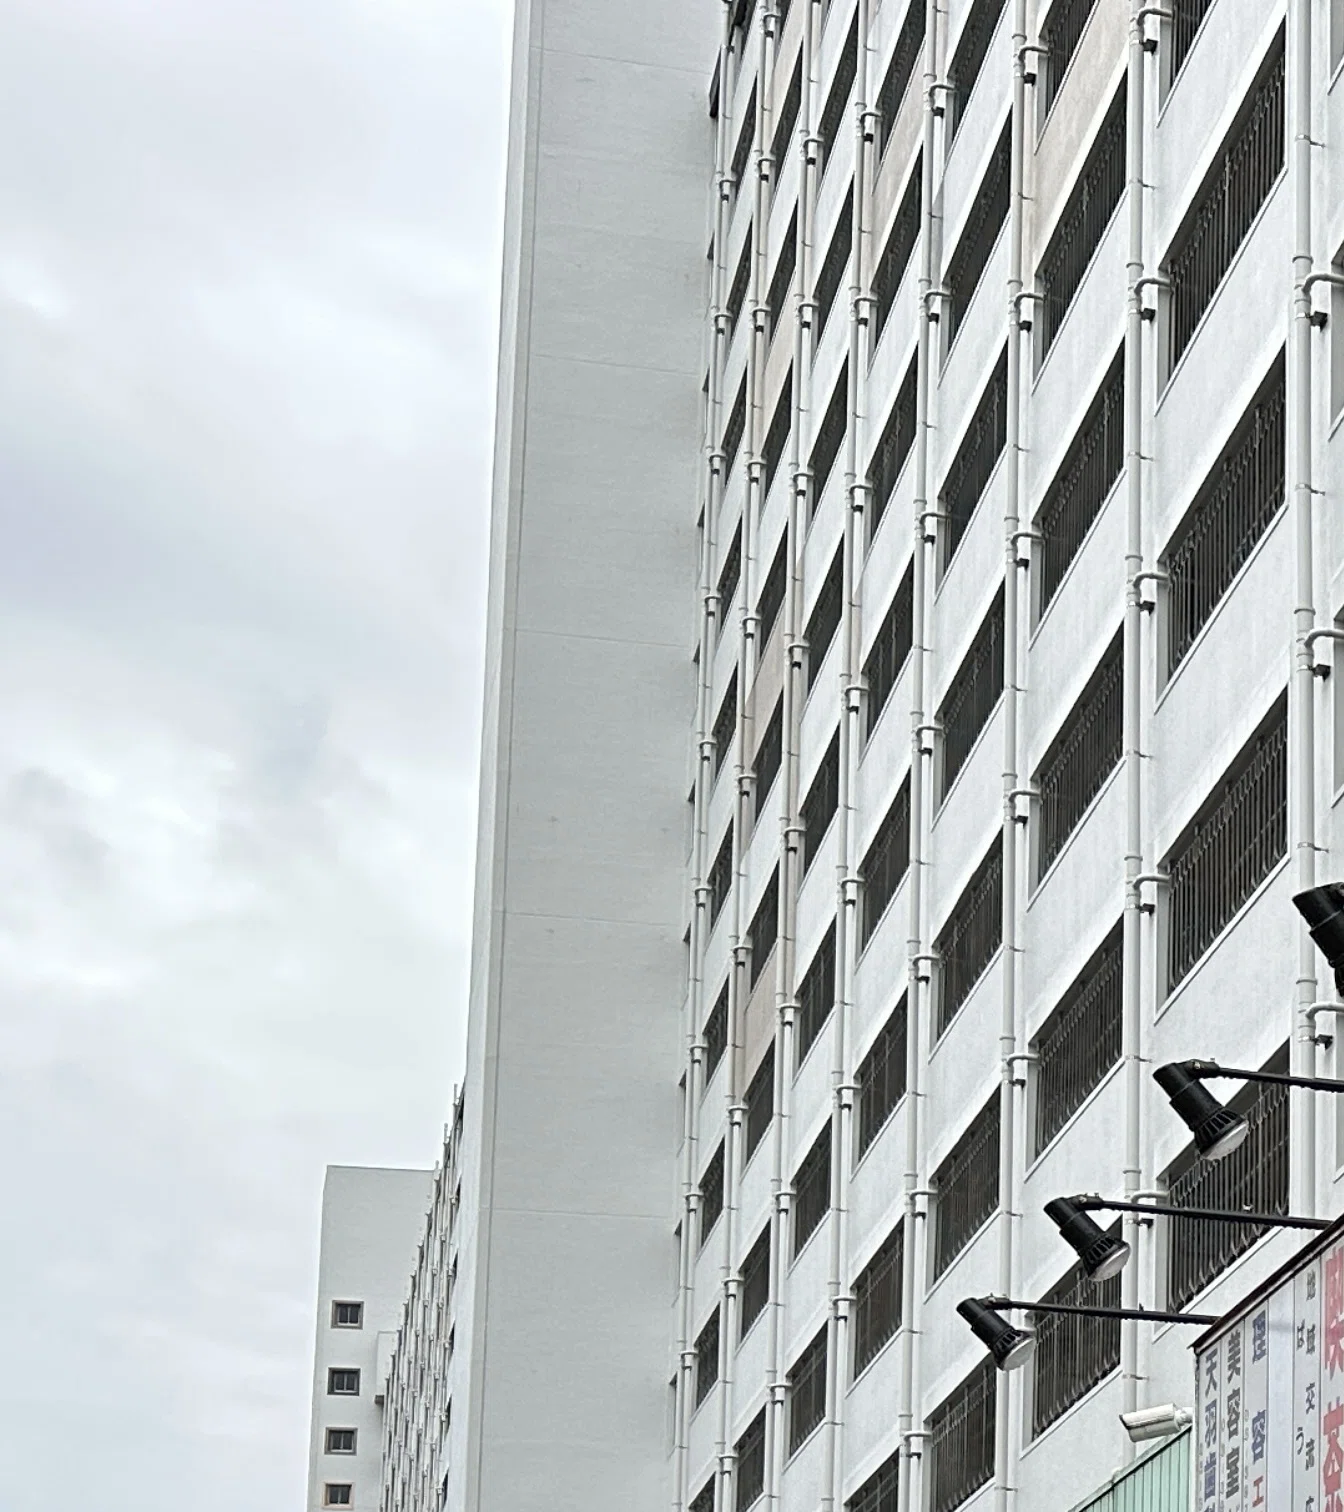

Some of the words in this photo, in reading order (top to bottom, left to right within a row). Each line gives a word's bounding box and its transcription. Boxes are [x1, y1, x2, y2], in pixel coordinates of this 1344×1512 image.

[1226, 1324, 1240, 1501] 美容室
[1251, 1308, 1266, 1466] 理容
